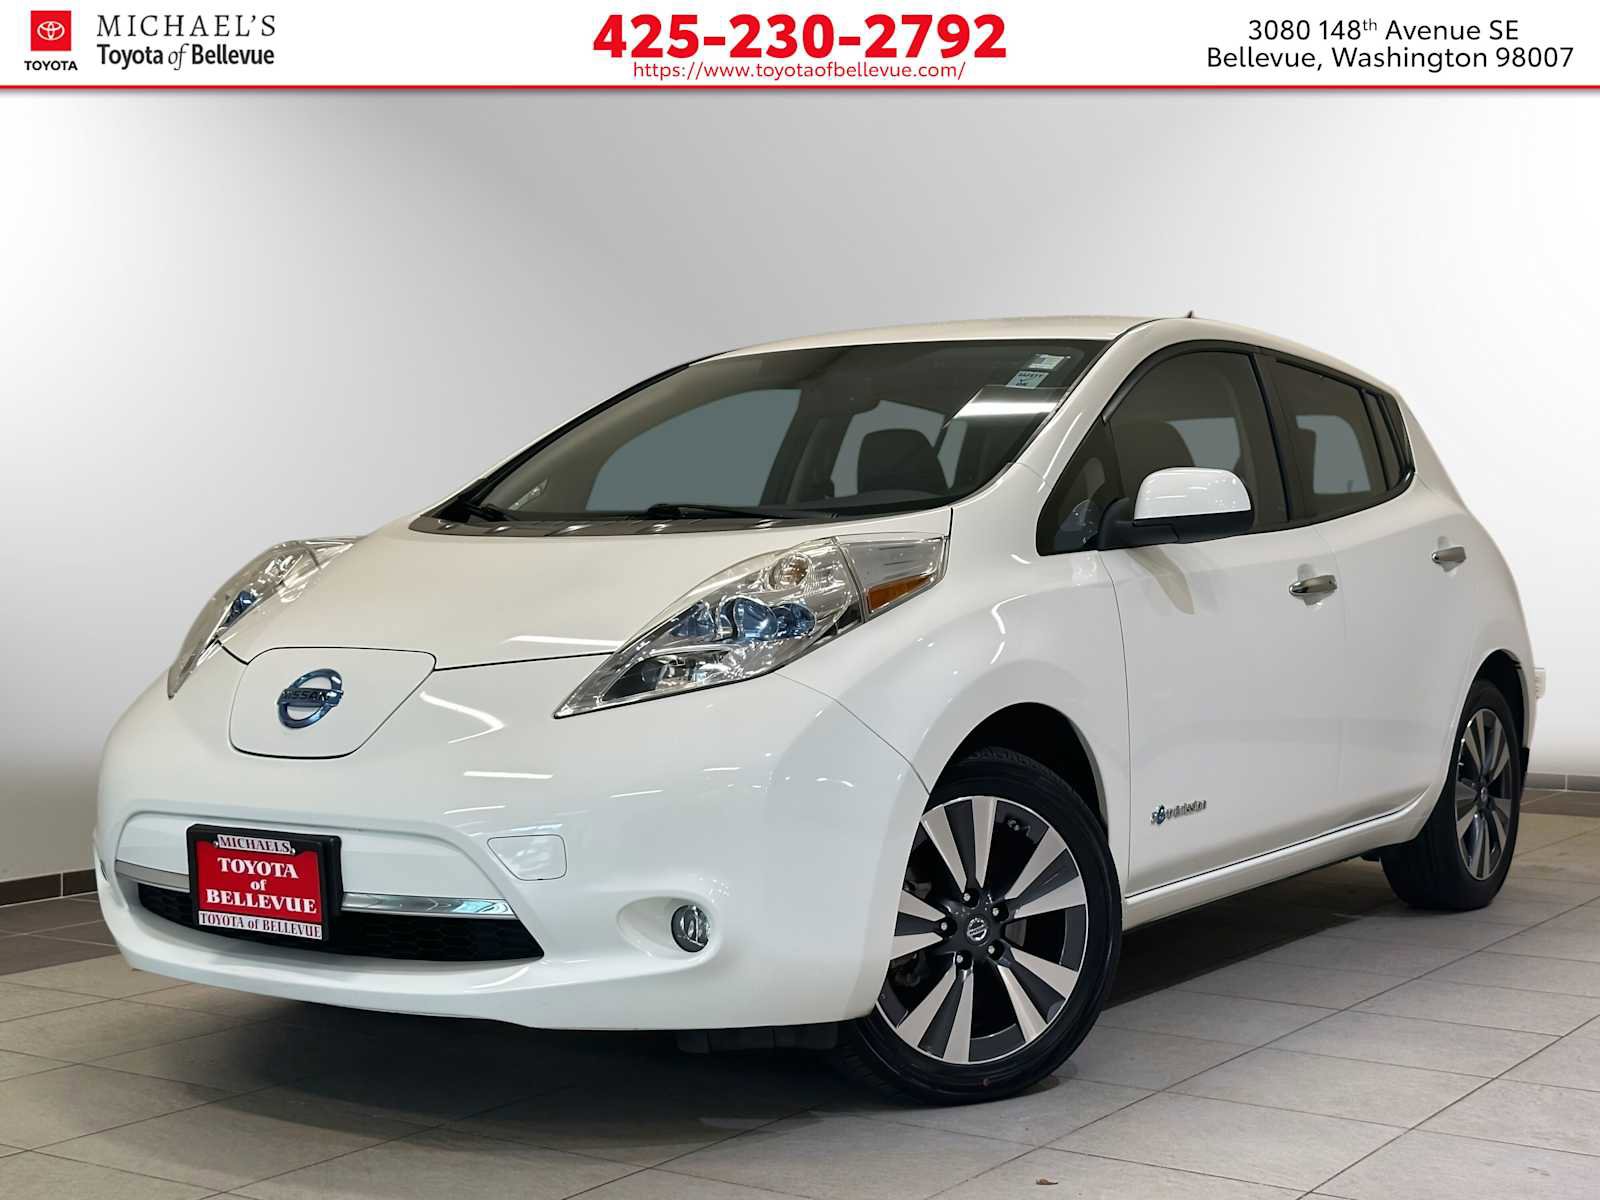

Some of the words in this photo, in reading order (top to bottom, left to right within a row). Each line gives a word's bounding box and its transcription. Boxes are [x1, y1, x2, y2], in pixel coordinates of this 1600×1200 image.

[217, 857, 299, 879] TOYOTA
[250, 879, 267, 891] of
[206, 888, 317, 913] BELLEVUE
[200, 912, 244, 928] TOYOTA
[247, 920, 258, 930] of
[263, 919, 321, 938] BELLEVUE
